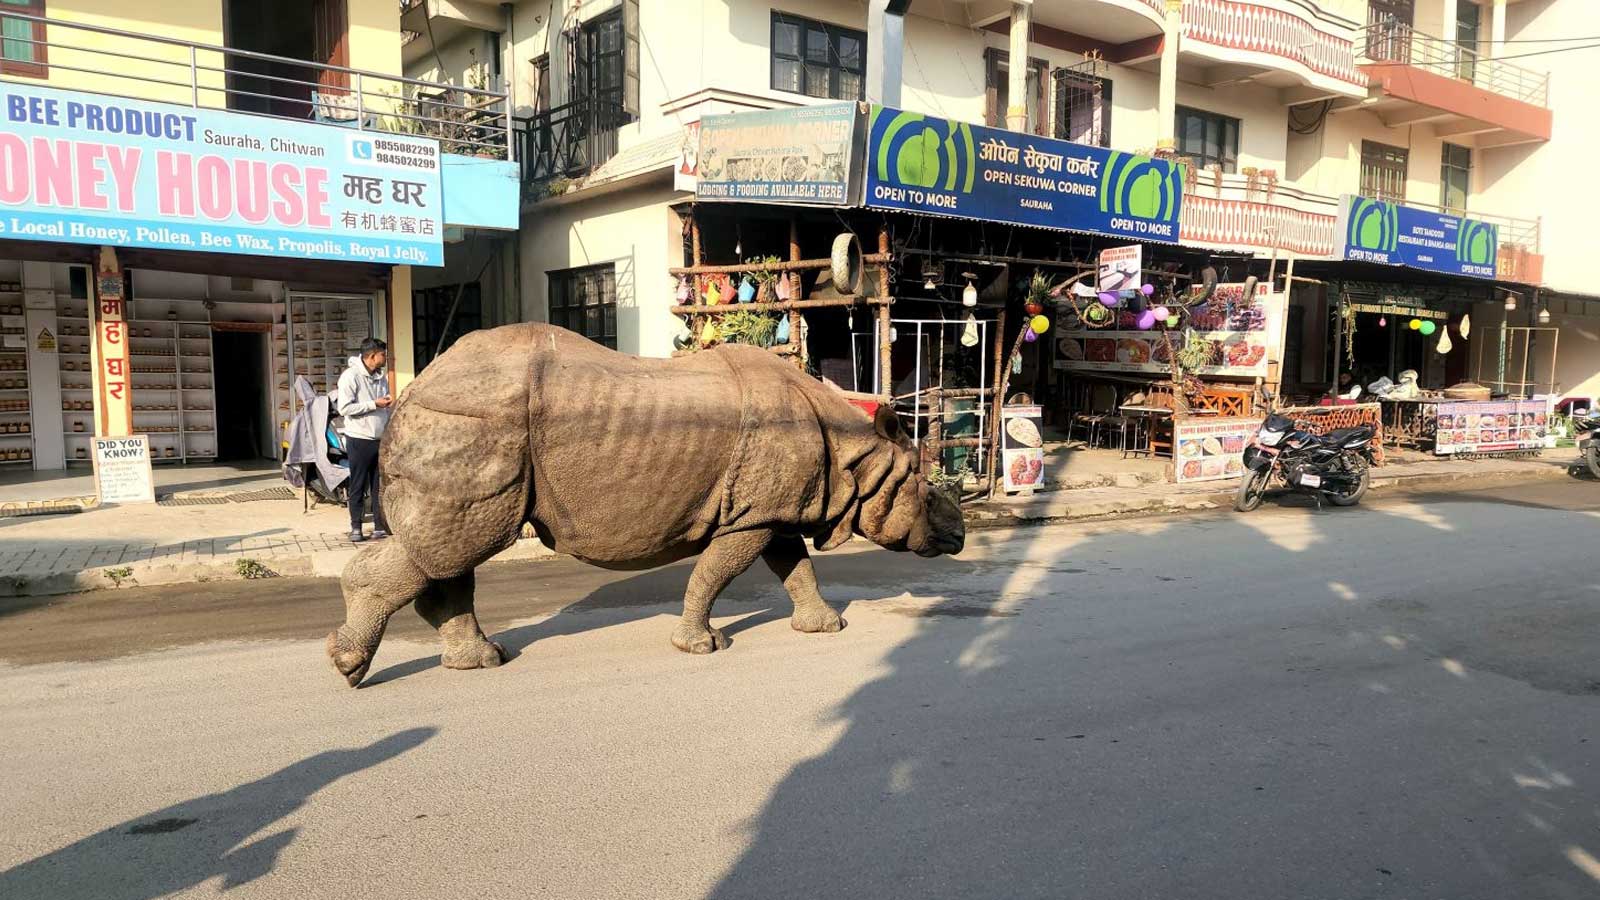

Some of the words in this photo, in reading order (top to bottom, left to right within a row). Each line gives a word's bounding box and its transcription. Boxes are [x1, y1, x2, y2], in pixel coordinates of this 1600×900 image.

[7, 94, 60, 126] BEE
[66, 101, 197, 142] PRODUCT
[204, 129, 265, 152] Sauraha,
[270, 137, 324, 157] Chitwan
[375, 139, 435, 156] 9855082299
[376, 153, 436, 169] 9845024299
[979, 138, 1020, 165] ओपेन
[1024, 145, 1064, 174] सेकुवा
[1066, 156, 1100, 178] कर्नर
[155, 149, 331, 228] HOUSE
[342, 174, 384, 204] मह
[391, 180, 427, 208] घर
[698, 184, 728, 196] LODGING
[730, 184, 734, 196] &
[736, 184, 768, 197] FOODING
[770, 184, 816, 198] AVAILABLE
[818, 185, 843, 199] HERE
[984, 169, 1012, 184] OPEN
[1014, 174, 1056, 192] SEKUWA
[1058, 181, 1097, 198] CORNER
[874, 186, 906, 202] OPEN
[908, 190, 924, 204] TO
[926, 192, 957, 208] MORE
[1020, 198, 1053, 211] SAURAHA
[341, 210, 434, 235] 有机蜂蜜店
[1110, 218, 1134, 232] OPEN
[1135, 220, 1147, 232] TO
[1148, 223, 1172, 236] MORE
[11, 218, 64, 237] Local
[69, 222, 131, 244] Honey,
[136, 226, 196, 246] Pollen,
[200, 231, 232, 247] Bee
[236, 234, 274, 251] Wax,
[278, 238, 346, 257] Propolis,
[350, 242, 390, 260] Royal
[394, 246, 428, 262] Jelly.
[1349, 248, 1364, 260] OPEN
[1365, 250, 1372, 260] TO
[1373, 252, 1388, 262] MORE
[1462, 264, 1474, 273] OPEN
[1474, 266, 1480, 274] TO
[1481, 266, 1493, 276] MORE
[97, 440, 117, 450] DID
[119, 439, 142, 448] YOU
[104, 448, 144, 459] KNOW?
